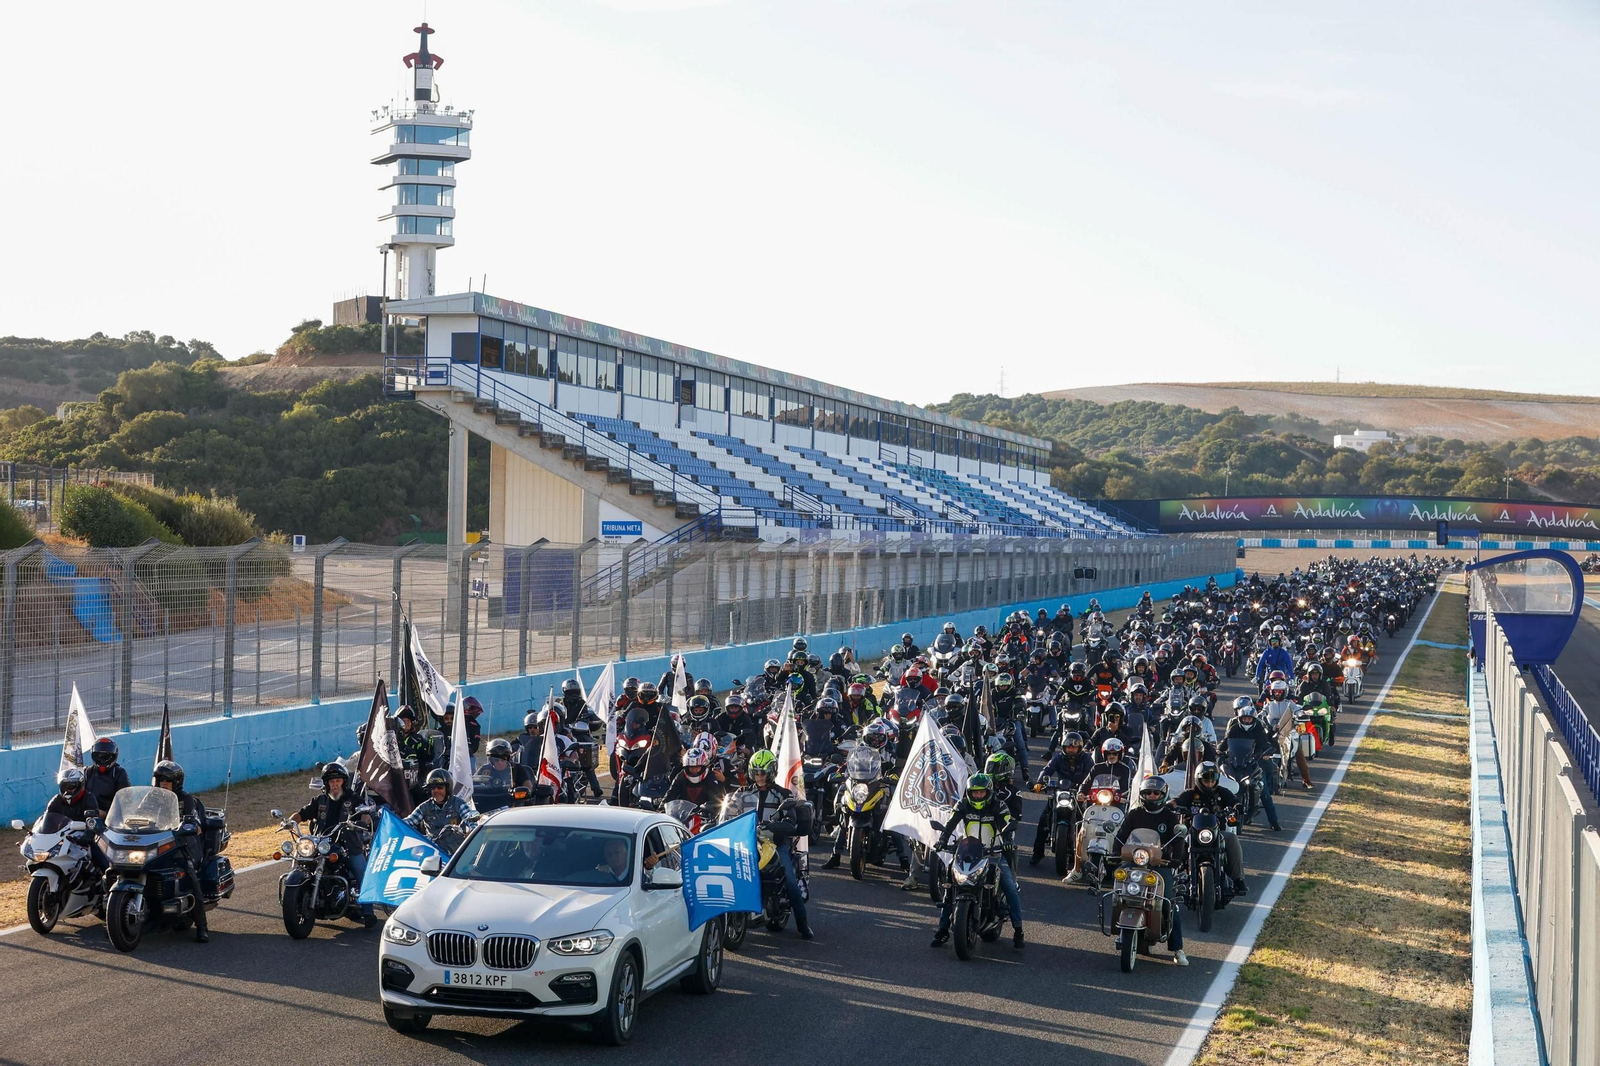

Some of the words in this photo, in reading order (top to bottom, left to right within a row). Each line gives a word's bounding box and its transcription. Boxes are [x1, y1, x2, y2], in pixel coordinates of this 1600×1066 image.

[1178, 503, 1250, 522] Andalucía
[1293, 501, 1366, 520] Andalucía
[1408, 503, 1482, 524] Andalucía
[1526, 510, 1600, 530] Andalucía
[740, 842, 752, 882] JEREZ
[693, 838, 735, 907] 40
[453, 973, 482, 986] 3812
[485, 975, 508, 987] KPF
